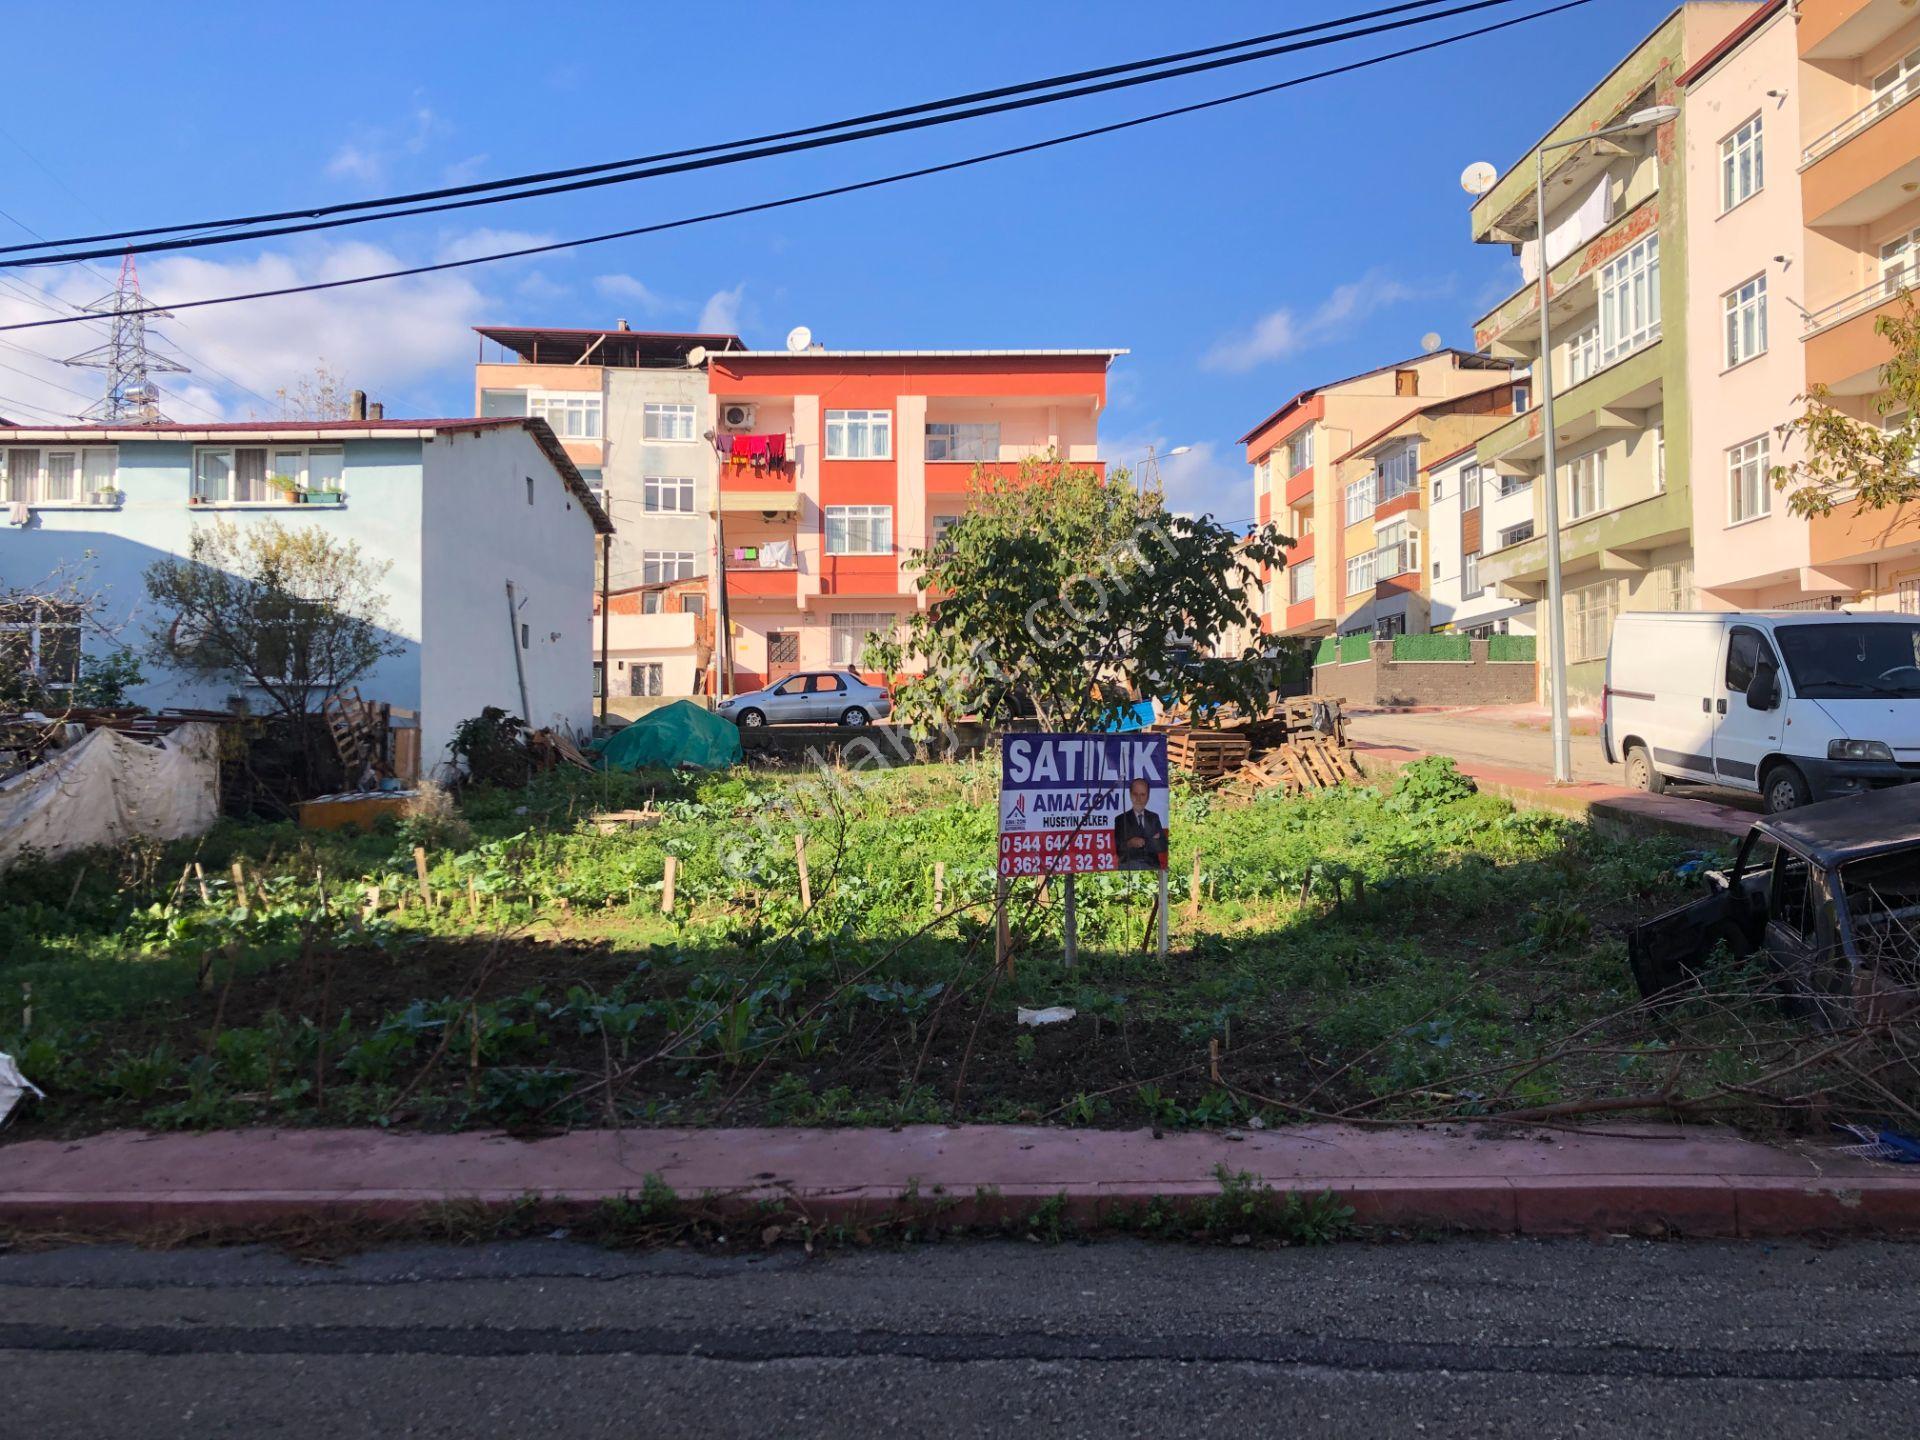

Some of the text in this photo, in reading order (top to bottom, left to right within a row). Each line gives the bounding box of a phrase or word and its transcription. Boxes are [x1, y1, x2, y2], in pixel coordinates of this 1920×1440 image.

[1009, 740, 1161, 783] SATILIK
[1043, 814, 1079, 828] HÜSEYİN
[1001, 832, 1111, 853] 0 544 644 47 51
[1000, 857, 1010, 874] 0
[1013, 856, 1041, 874] 362
[1075, 854, 1094, 871] 32
[1097, 853, 1114, 870] 32
